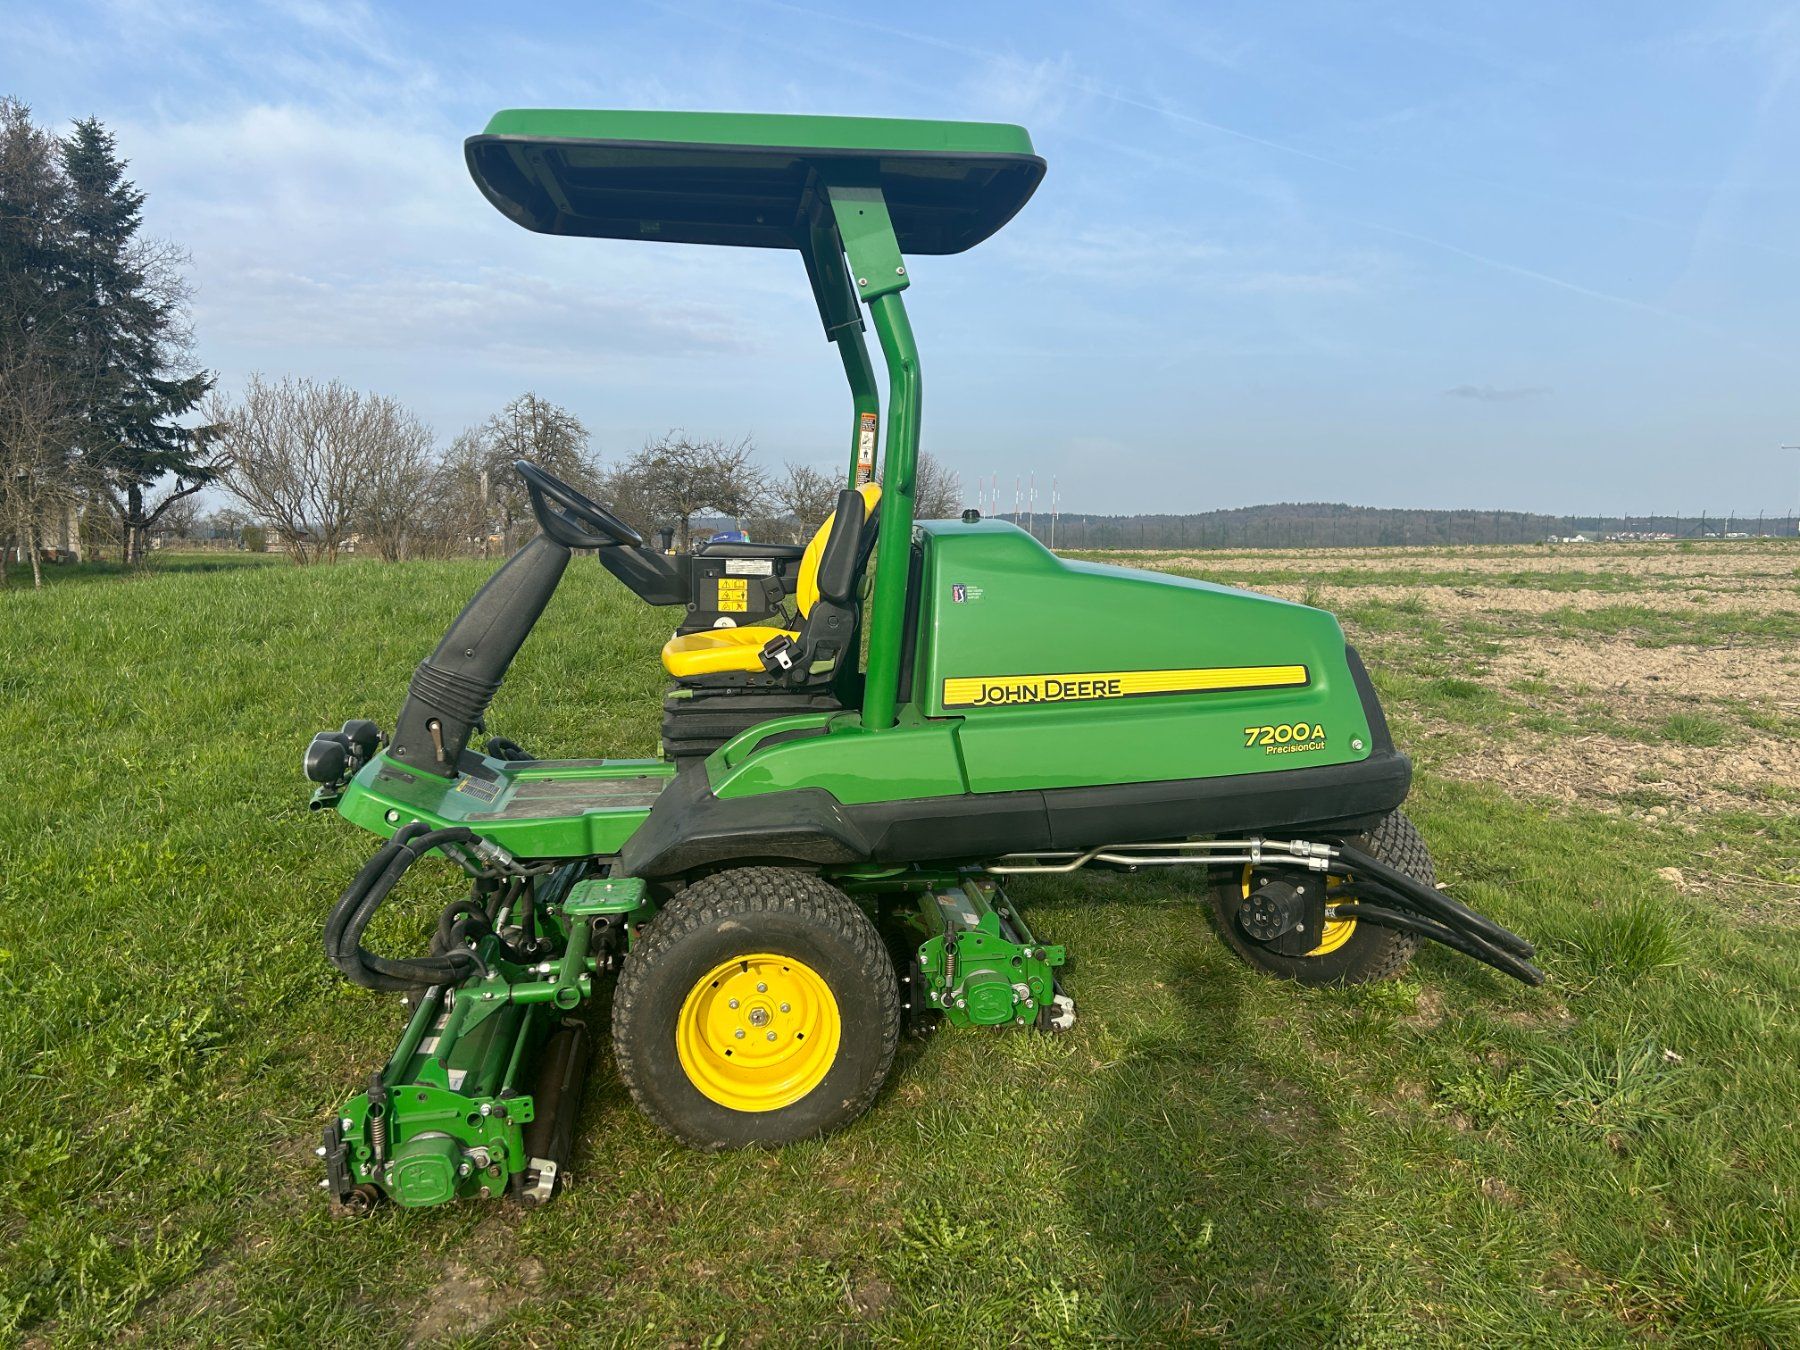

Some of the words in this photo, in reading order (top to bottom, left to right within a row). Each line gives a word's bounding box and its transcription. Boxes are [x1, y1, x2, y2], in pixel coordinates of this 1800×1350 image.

[974, 684, 1038, 704] JOHN
[1044, 679, 1122, 699] DEERE
[1243, 722, 1327, 748] 7200A
[1265, 741, 1326, 755] PrecisionCut
